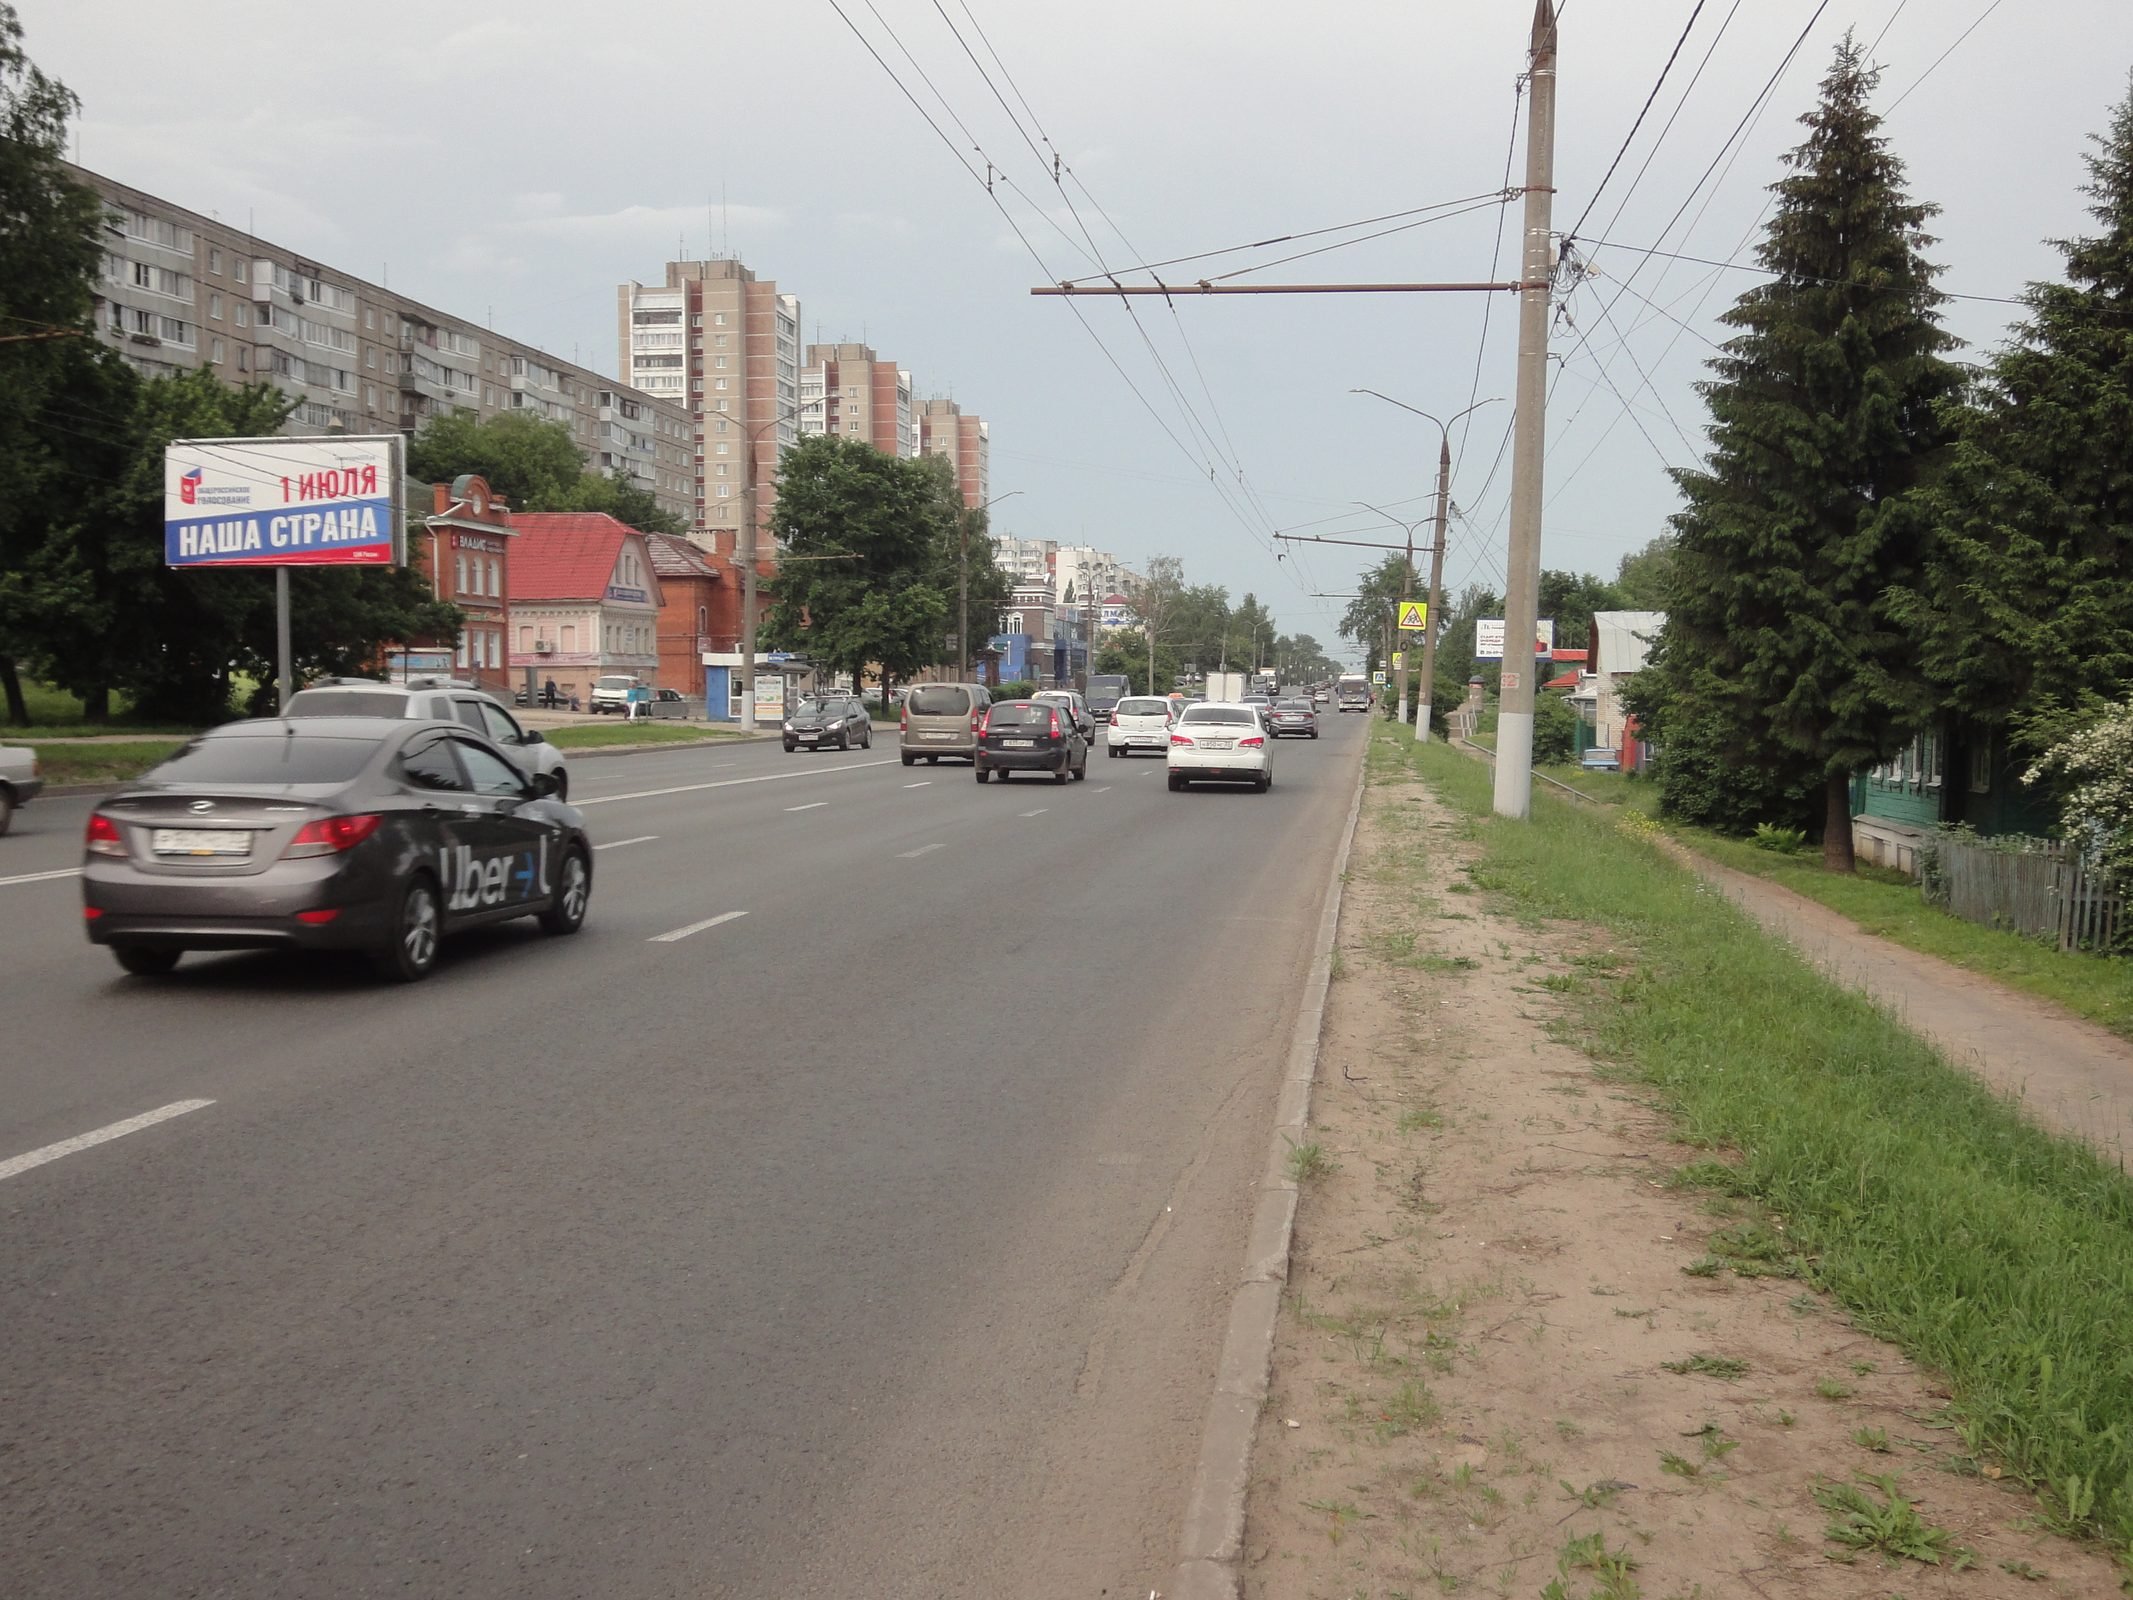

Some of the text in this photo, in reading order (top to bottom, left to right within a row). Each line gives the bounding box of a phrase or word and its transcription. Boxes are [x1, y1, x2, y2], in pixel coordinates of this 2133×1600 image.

[280, 464, 376, 503] 1 ИЮЛЯ
[179, 507, 378, 557] НАША СТРАНА
[440, 844, 514, 911] Uber
